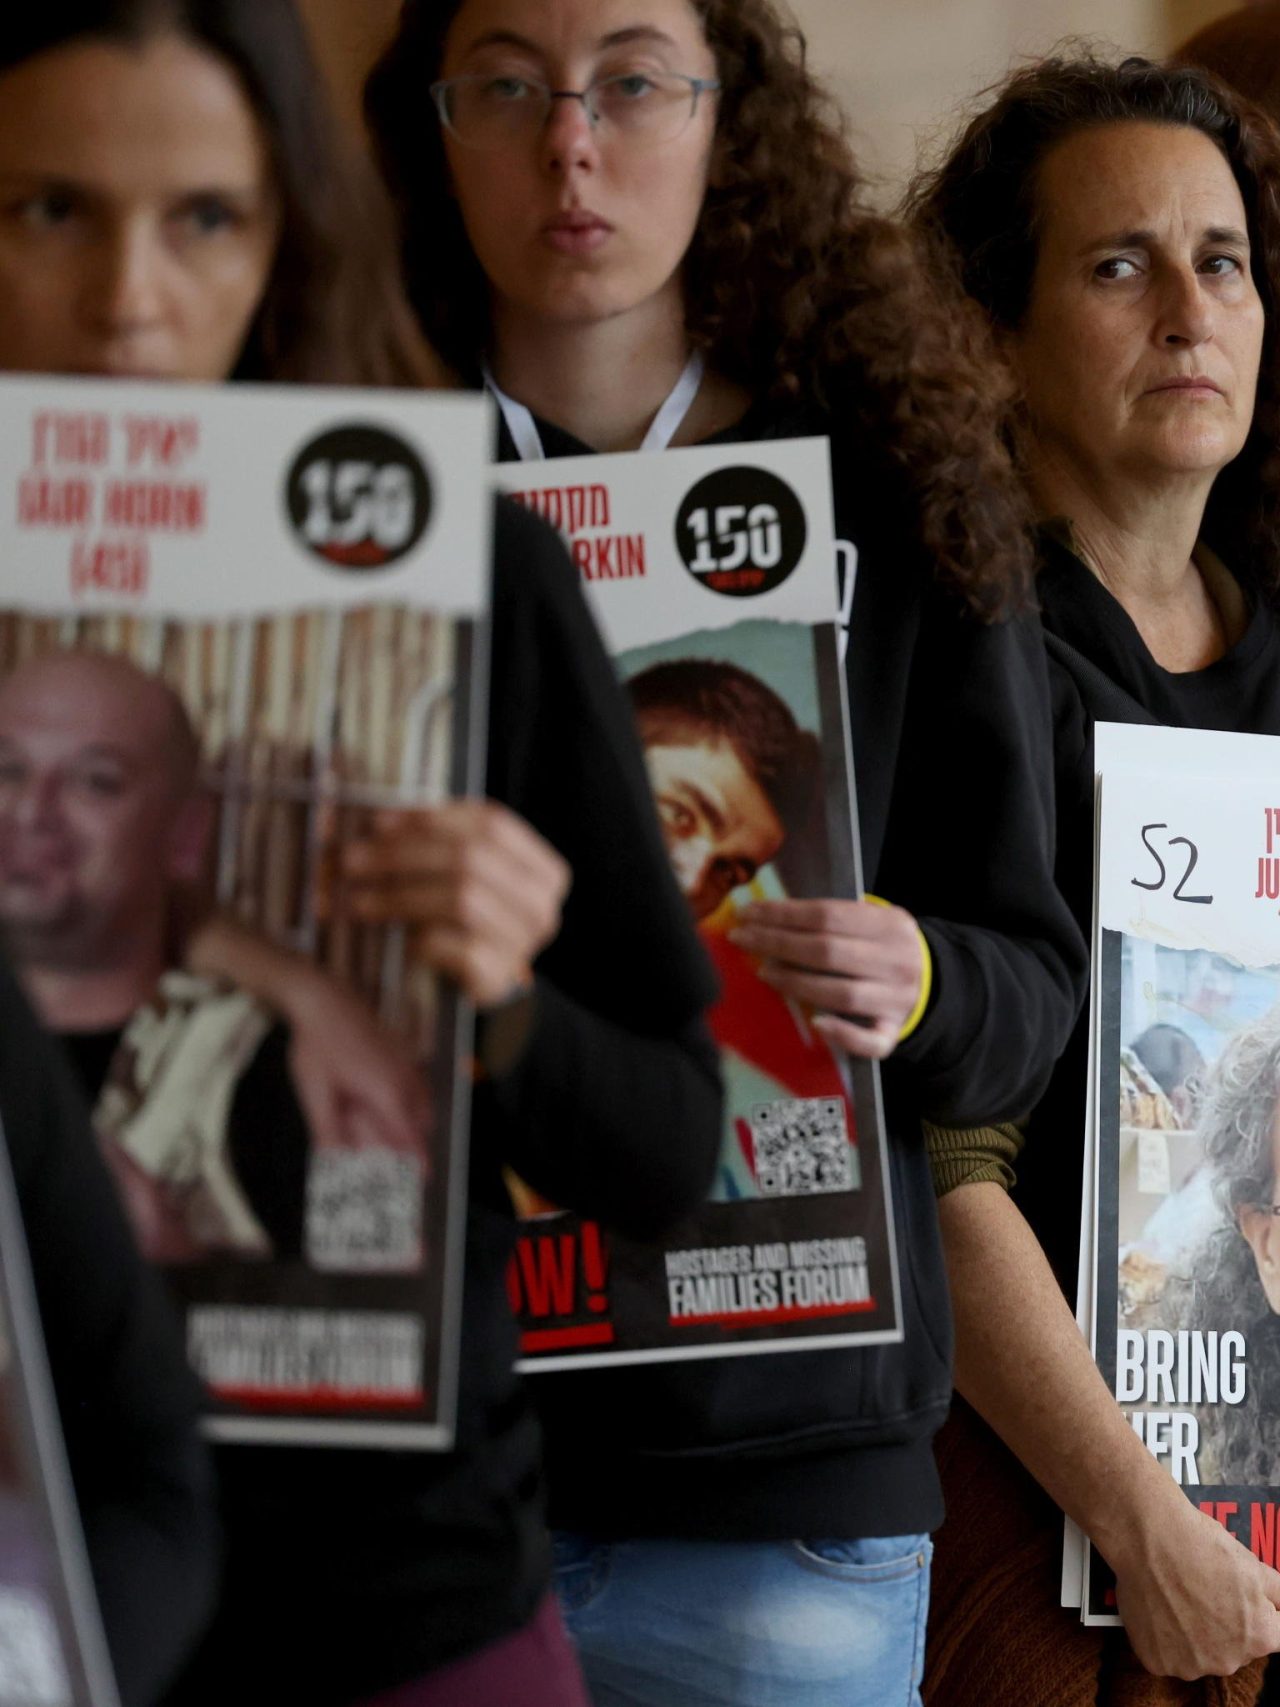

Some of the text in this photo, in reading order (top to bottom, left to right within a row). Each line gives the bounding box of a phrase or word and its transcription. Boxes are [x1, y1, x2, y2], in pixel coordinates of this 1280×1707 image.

[301, 457, 415, 549] 150
[572, 532, 646, 580] RKIN
[687, 503, 782, 573] 150
[753, 1242, 788, 1271] AND
[789, 1236, 867, 1269] MISSING
[669, 1263, 871, 1318] FAMILIES FORUM
[1116, 1329, 1246, 1404] BRING
